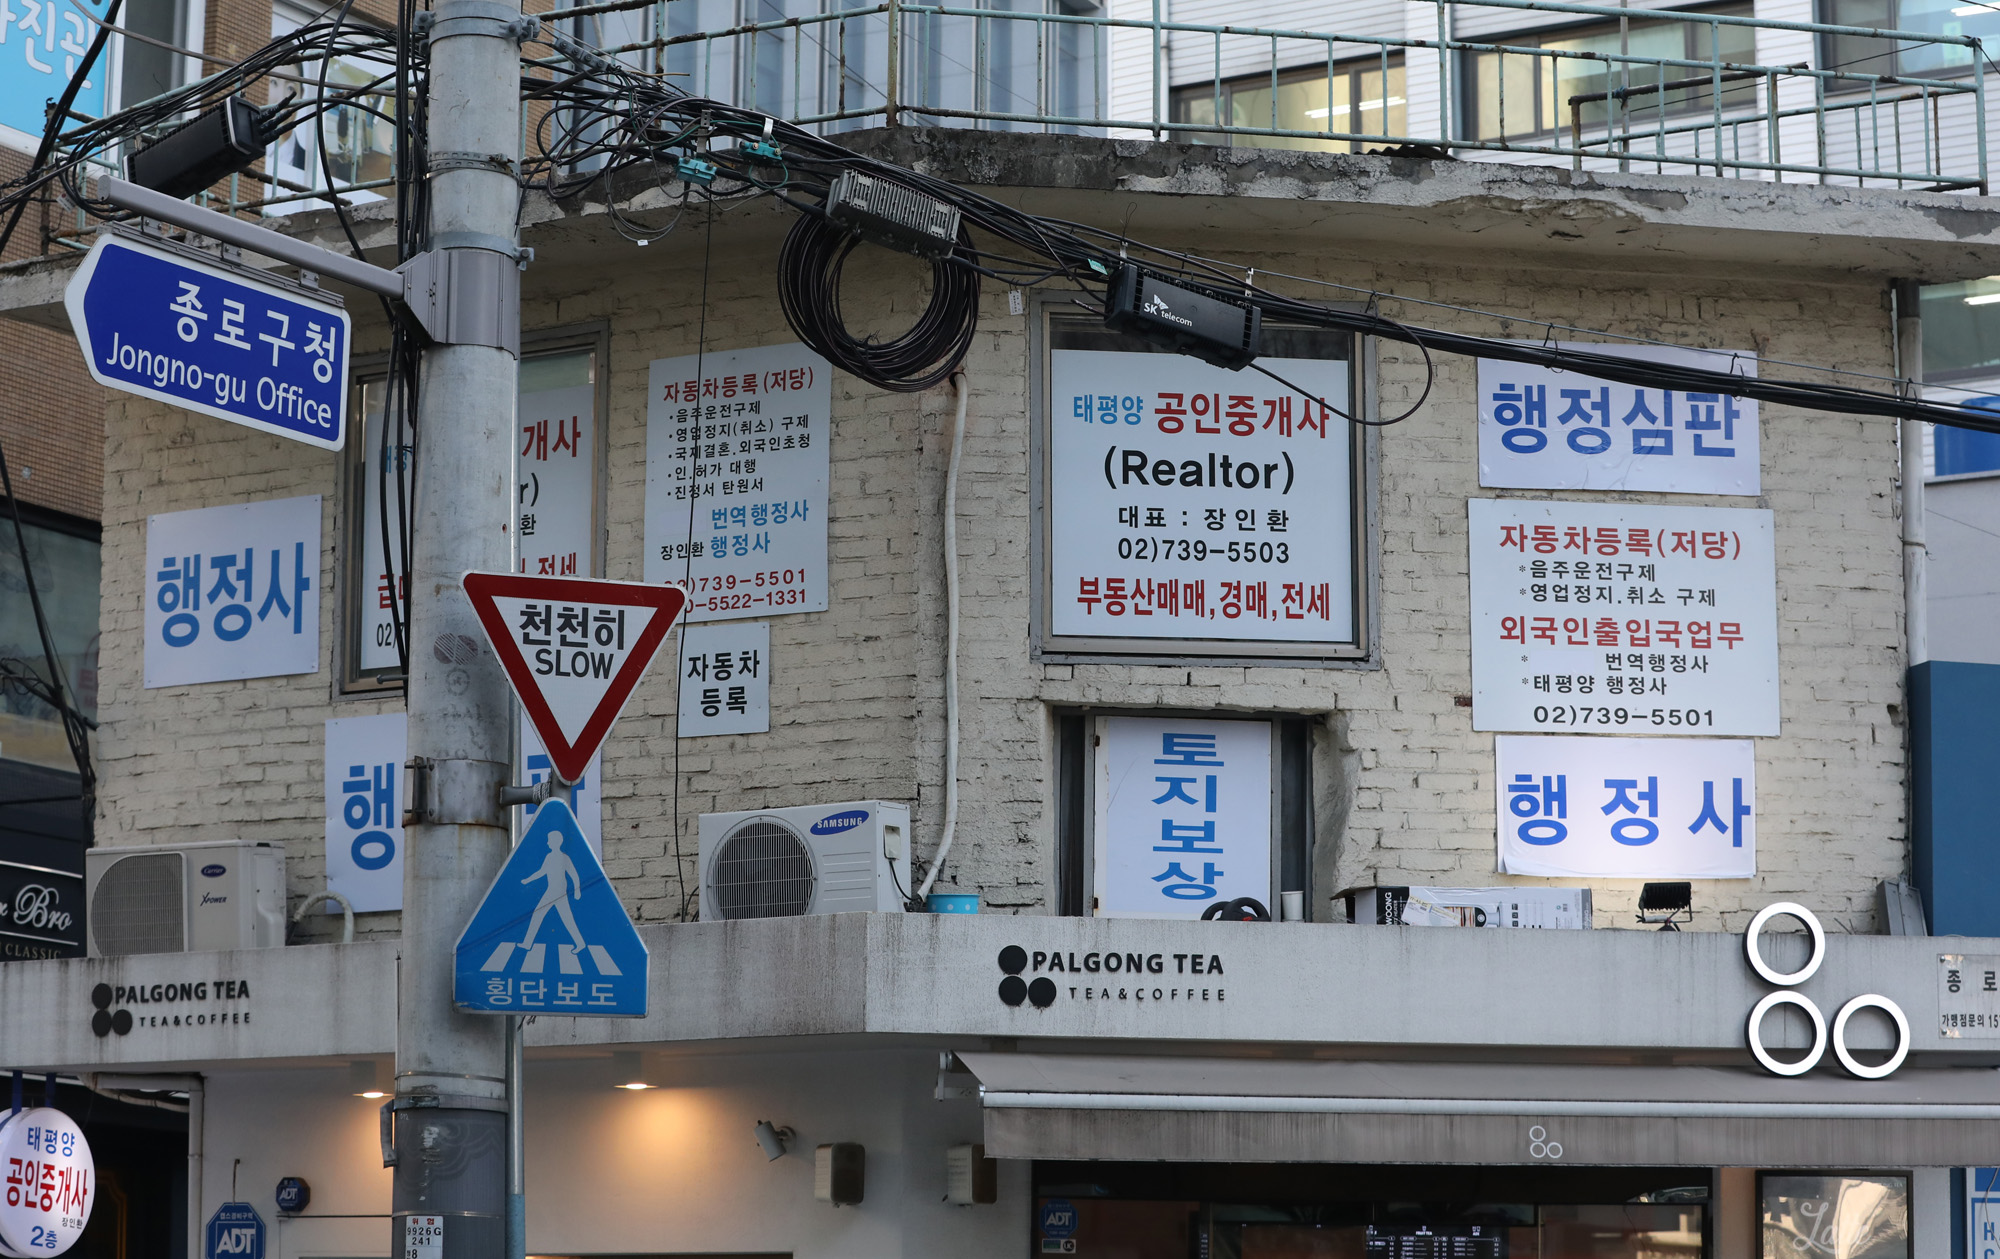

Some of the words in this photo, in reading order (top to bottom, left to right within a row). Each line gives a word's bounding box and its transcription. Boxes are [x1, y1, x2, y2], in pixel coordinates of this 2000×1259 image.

[0, 0, 96, 90] 진관
[1143, 301, 1159, 316] SK
[1160, 310, 1193, 327] telecom
[169, 280, 337, 384] 종로구청
[106, 332, 246, 405] Jongno-gu
[256, 376, 332, 429] Office
[676, 400, 761, 424] 음주운전구제
[1073, 394, 1144, 426] 태평양
[1153, 392, 1330, 439] 공인중개사
[1492, 383, 1741, 458] 행정심판
[676, 418, 774, 443] 영업정지(취소)
[781, 414, 809, 431] 구제
[729, 458, 757, 475] 대행
[1104, 445, 1295, 495] (Realtor)
[674, 482, 715, 500] 진정서
[722, 477, 764, 495] 탄원서
[711, 499, 809, 530] 번역행정사
[1118, 505, 1167, 529] 대표
[660, 541, 704, 561] 장인환
[710, 531, 771, 559] 행정사
[1117, 537, 1290, 564] 02)739-5503
[1499, 523, 1741, 561] 자동차등록(저당)
[1529, 560, 1656, 582] 음주운전구제
[156, 541, 310, 648] 행정사
[1676, 587, 1716, 607] 구제
[519, 603, 625, 650] 천천히
[1499, 615, 1745, 650] 외국인출입국업무
[535, 647, 614, 680] SLOW
[687, 649, 760, 682] 자동차
[1605, 652, 1709, 674] 번역행정사
[1533, 675, 1595, 694] 태평양
[1606, 675, 1668, 696] 행정사
[700, 685, 748, 717] 등록
[1533, 704, 1714, 727] 02)739-5501
[817, 816, 863, 829] SAMSUNG
[1151, 732, 1225, 901] 토지보상
[13, 883, 73, 932] Bro
[1032, 951, 1164, 974] PALGONG
[1173, 953, 1224, 975] TEA
[114, 982, 207, 1005] PALGONG
[213, 980, 250, 999] TEA
[485, 977, 618, 1007] 횡단보도
[1068, 987, 1226, 1001] TEA&COFFEE
[139, 1011, 251, 1028] TEA&COFFEE
[1941, 1013, 1985, 1028] 가맹점문의
[27, 1126, 75, 1157] 태평양
[6, 1157, 88, 1217] 공인중개사
[279, 1188, 298, 1200] ADT
[1046, 1212, 1072, 1226] ADT
[30, 1225, 58, 1249] 2층
[216, 1228, 256, 1254] ADT
[411, 1236, 431, 1246] 241
[411, 1248, 418, 1259] 8
